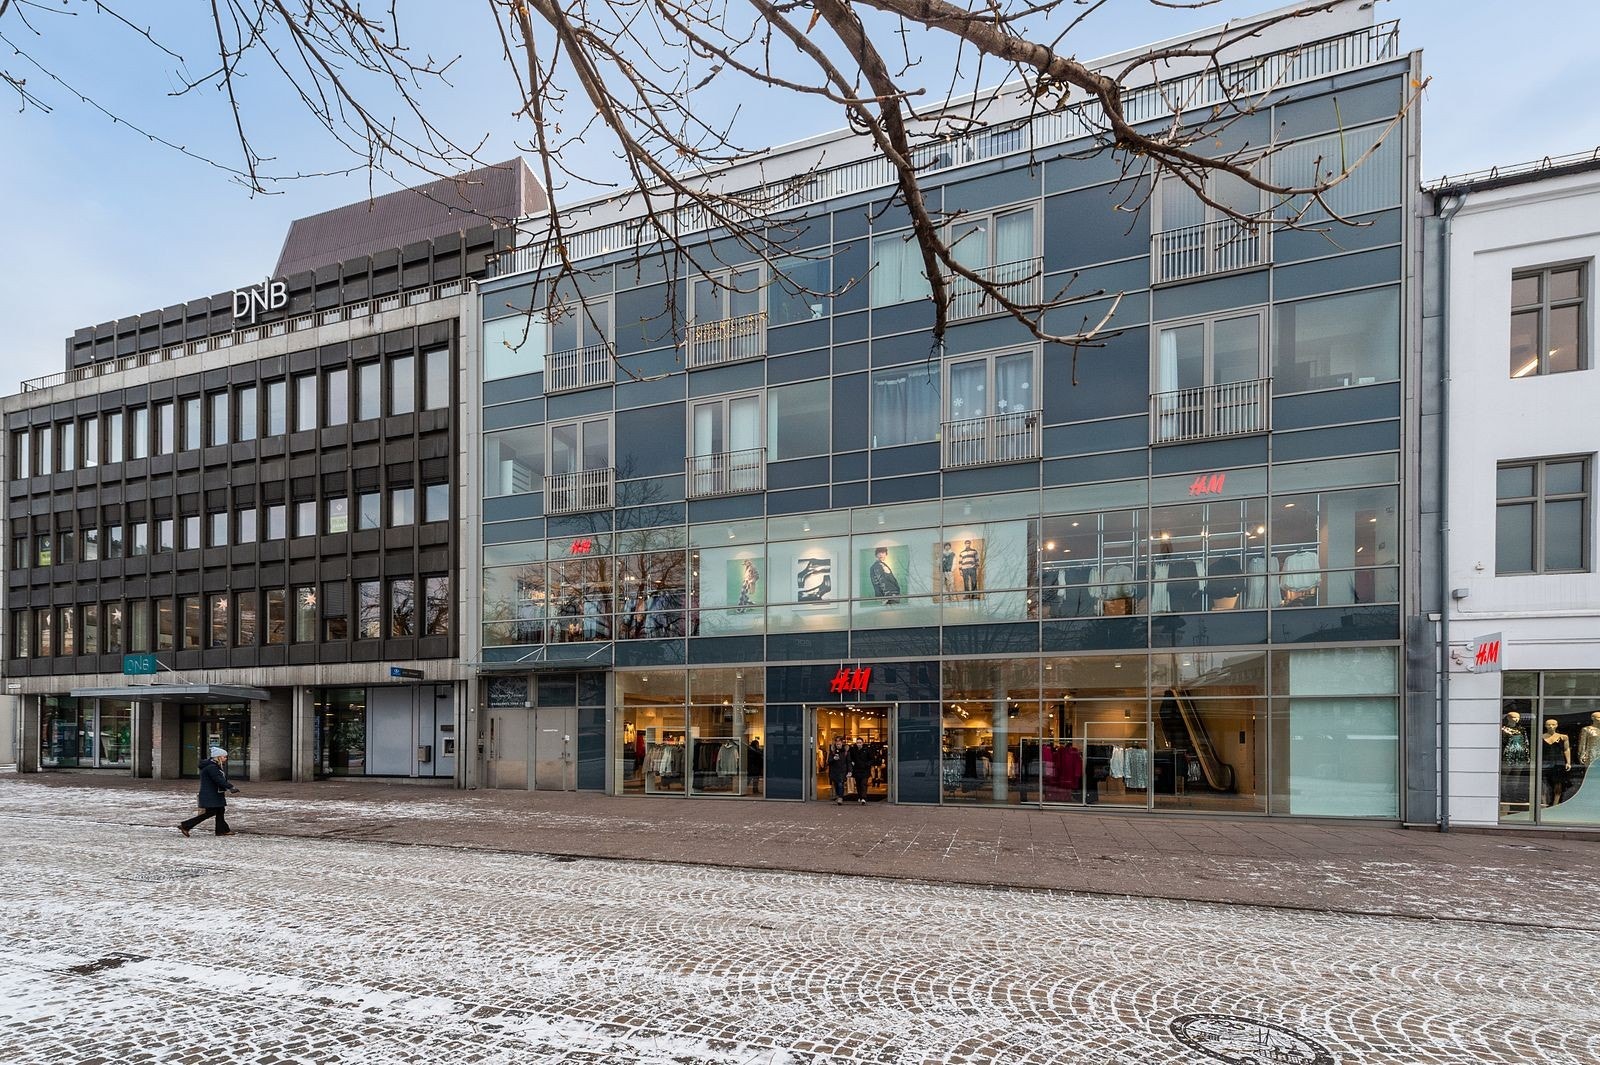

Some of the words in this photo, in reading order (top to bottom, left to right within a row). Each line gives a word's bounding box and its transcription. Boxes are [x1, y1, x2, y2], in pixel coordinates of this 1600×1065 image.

[233, 276, 287, 324] DNB
[1189, 472, 1226, 496] H&M
[127, 655, 149, 673] DNB
[1475, 640, 1500, 667] H&M
[830, 667, 872, 693] H&M
